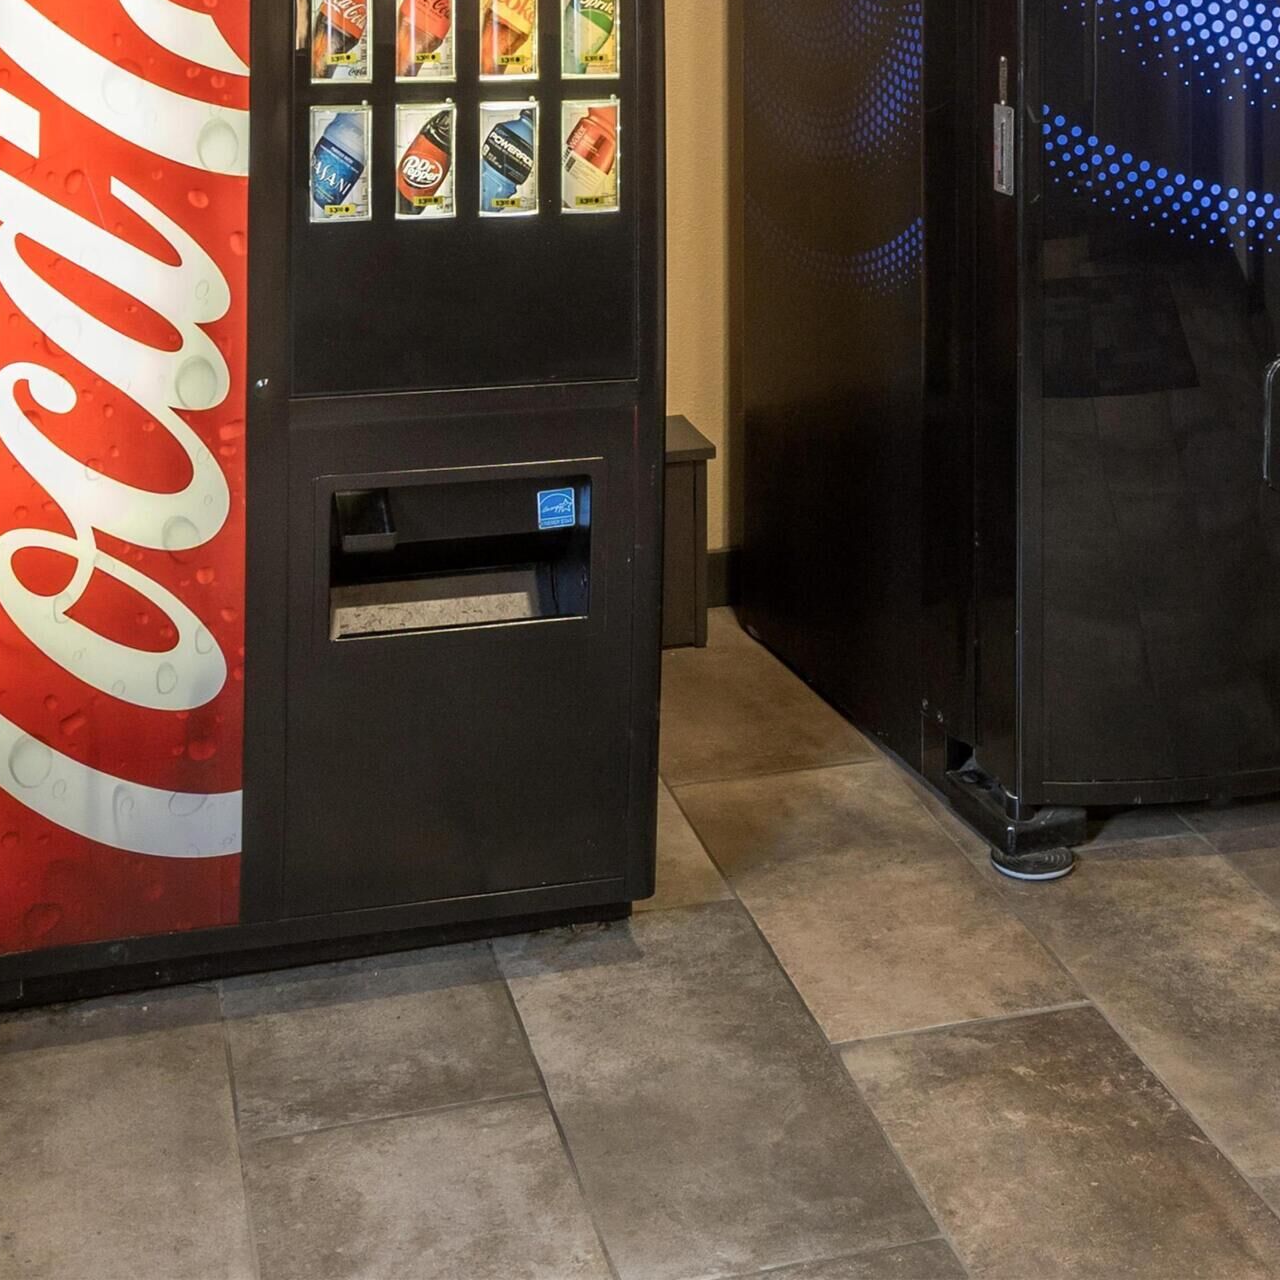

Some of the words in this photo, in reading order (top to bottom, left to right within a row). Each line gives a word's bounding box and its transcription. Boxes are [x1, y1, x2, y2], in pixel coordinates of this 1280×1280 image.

[489, 131, 534, 168] POWERAD
[403, 157, 440, 182] Pepper
[419, 158, 436, 173] Dr
